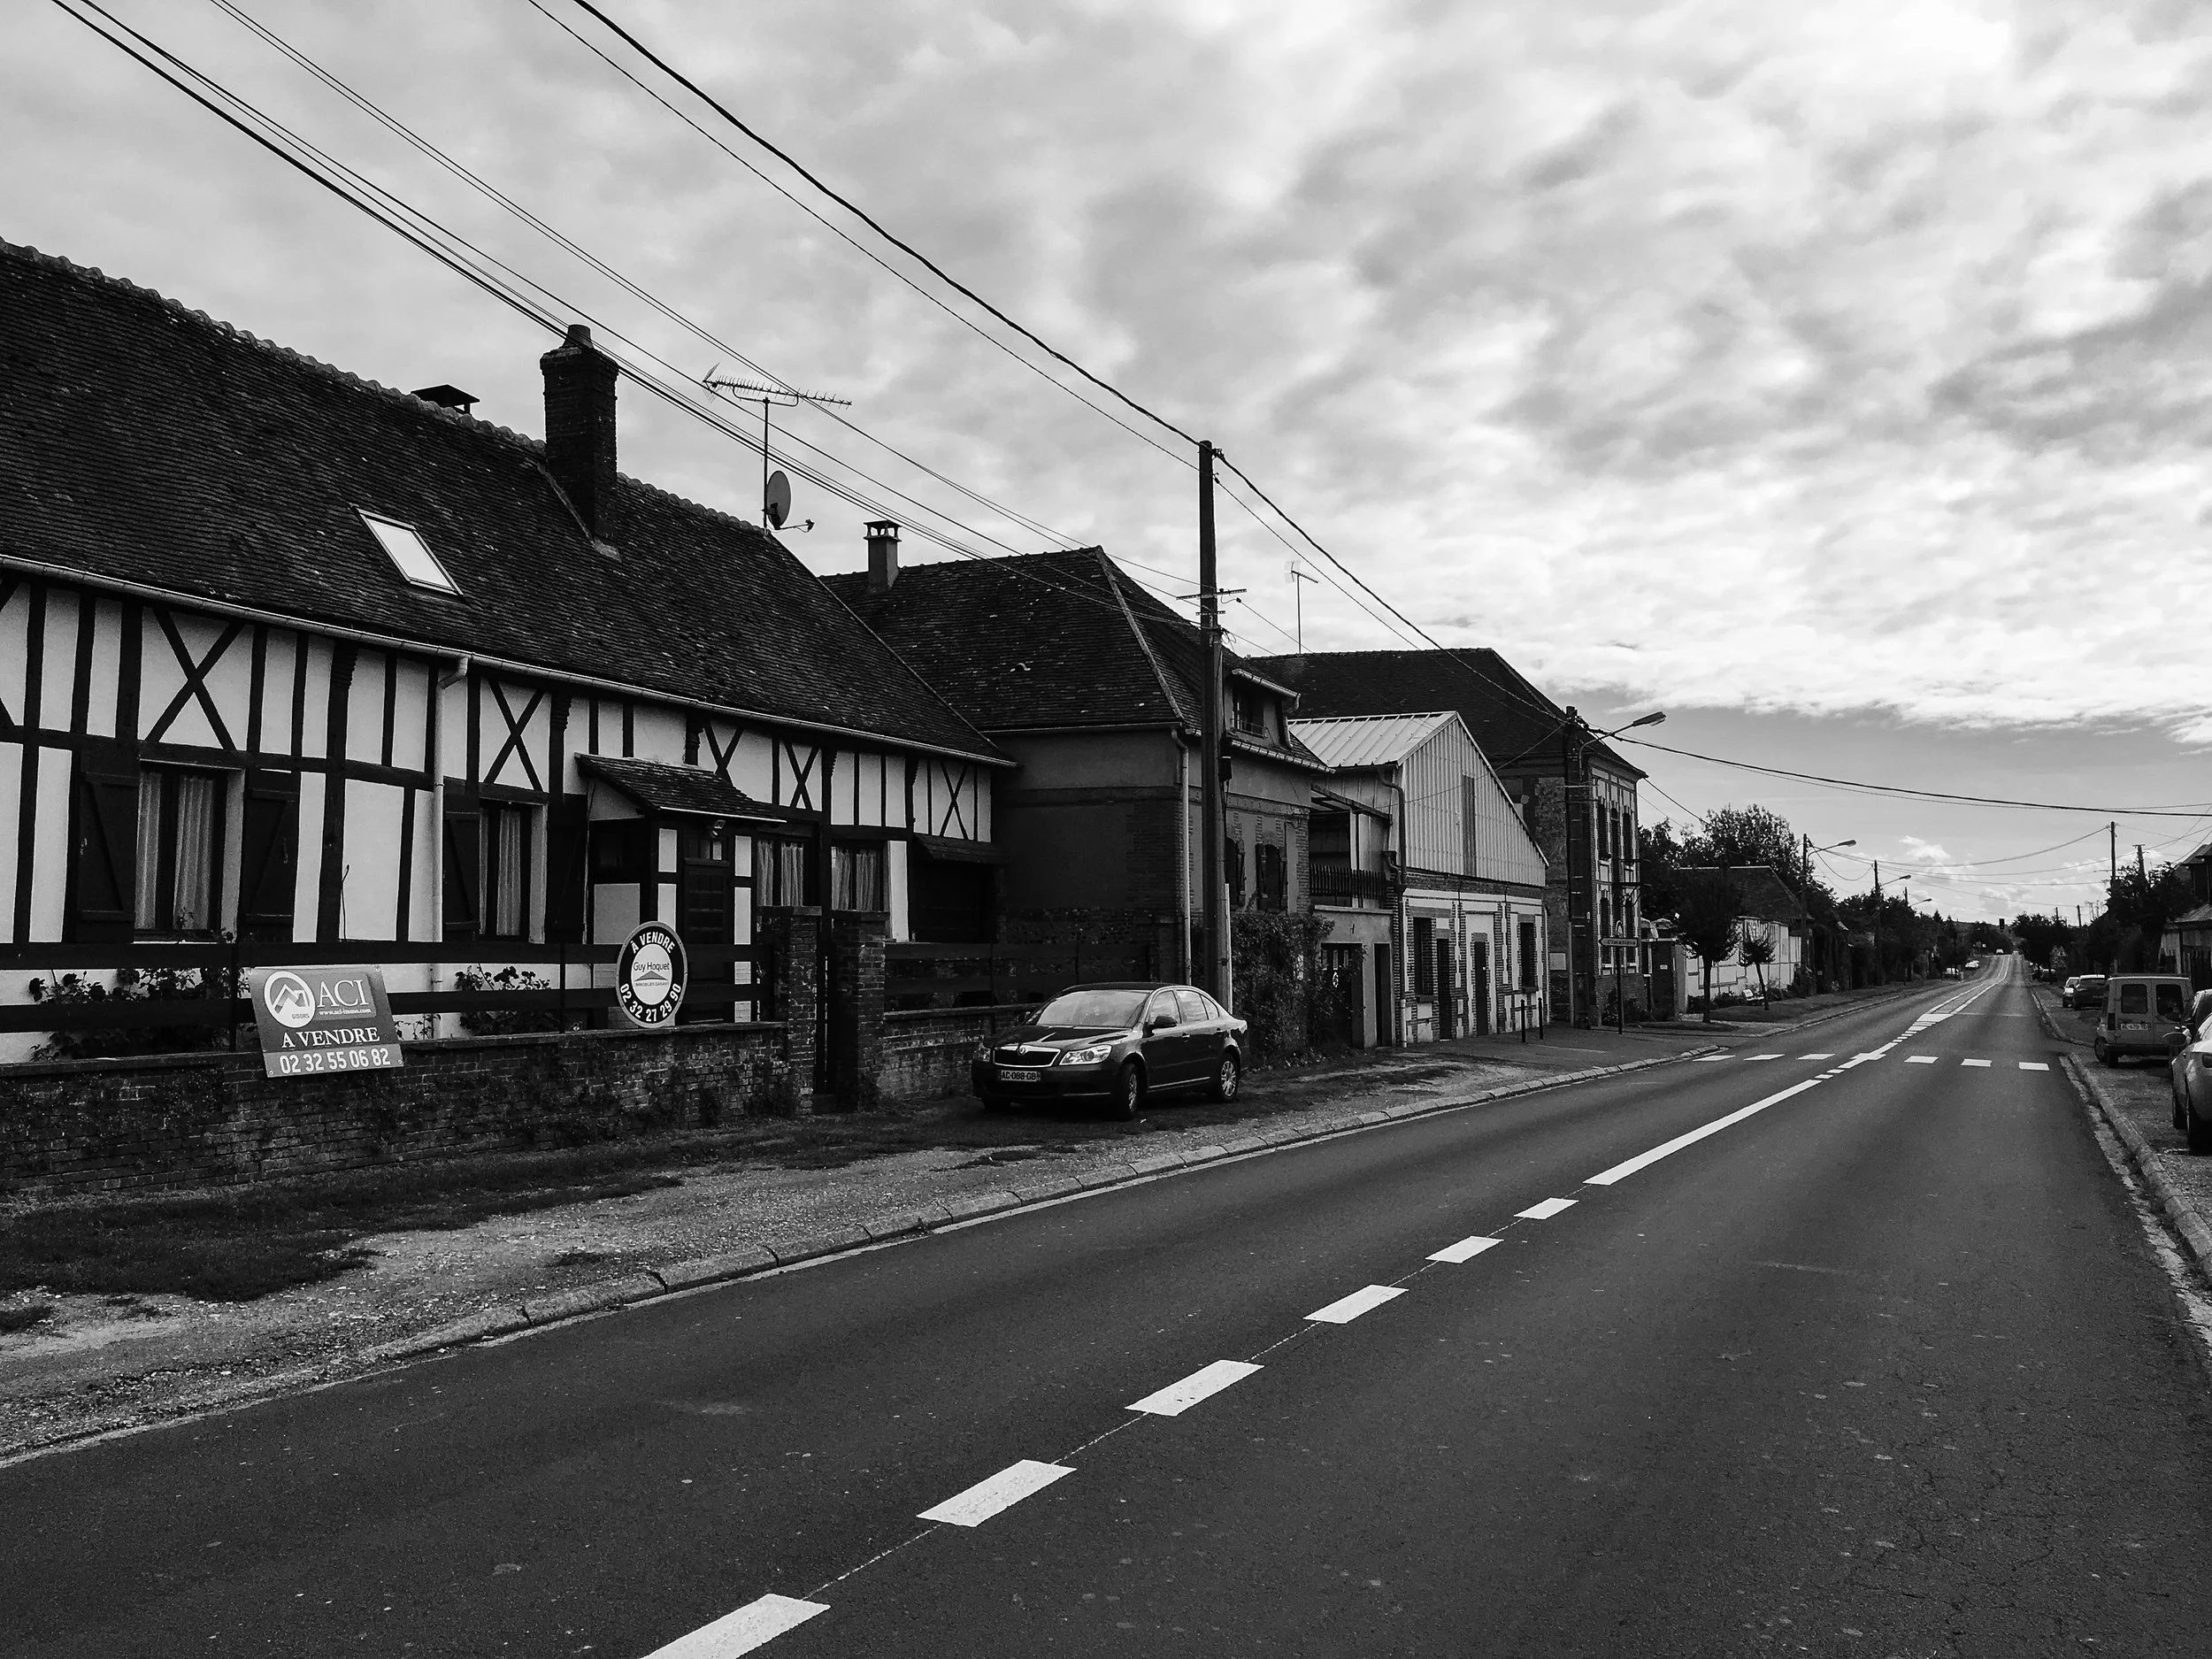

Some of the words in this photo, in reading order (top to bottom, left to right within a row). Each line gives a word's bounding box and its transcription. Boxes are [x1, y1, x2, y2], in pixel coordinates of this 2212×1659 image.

[639, 932, 675, 954] VENDRE
[633, 962, 645, 972] Guy
[647, 962, 670, 972] Hoquet
[317, 979, 370, 1008] ACI
[620, 983, 632, 1002] 02
[629, 1001, 642, 1018] 32
[646, 1009, 657, 1022] 27
[660, 1000, 672, 1018] 29
[670, 983, 681, 1001] 90
[281, 1032, 296, 1048] A
[296, 1027, 380, 1047] VENDRE
[279, 1054, 301, 1074] 02
[303, 1052, 325, 1072] 32
[326, 1050, 347, 1071] 55
[349, 1049, 369, 1068] 06
[371, 1048, 391, 1066] 82
